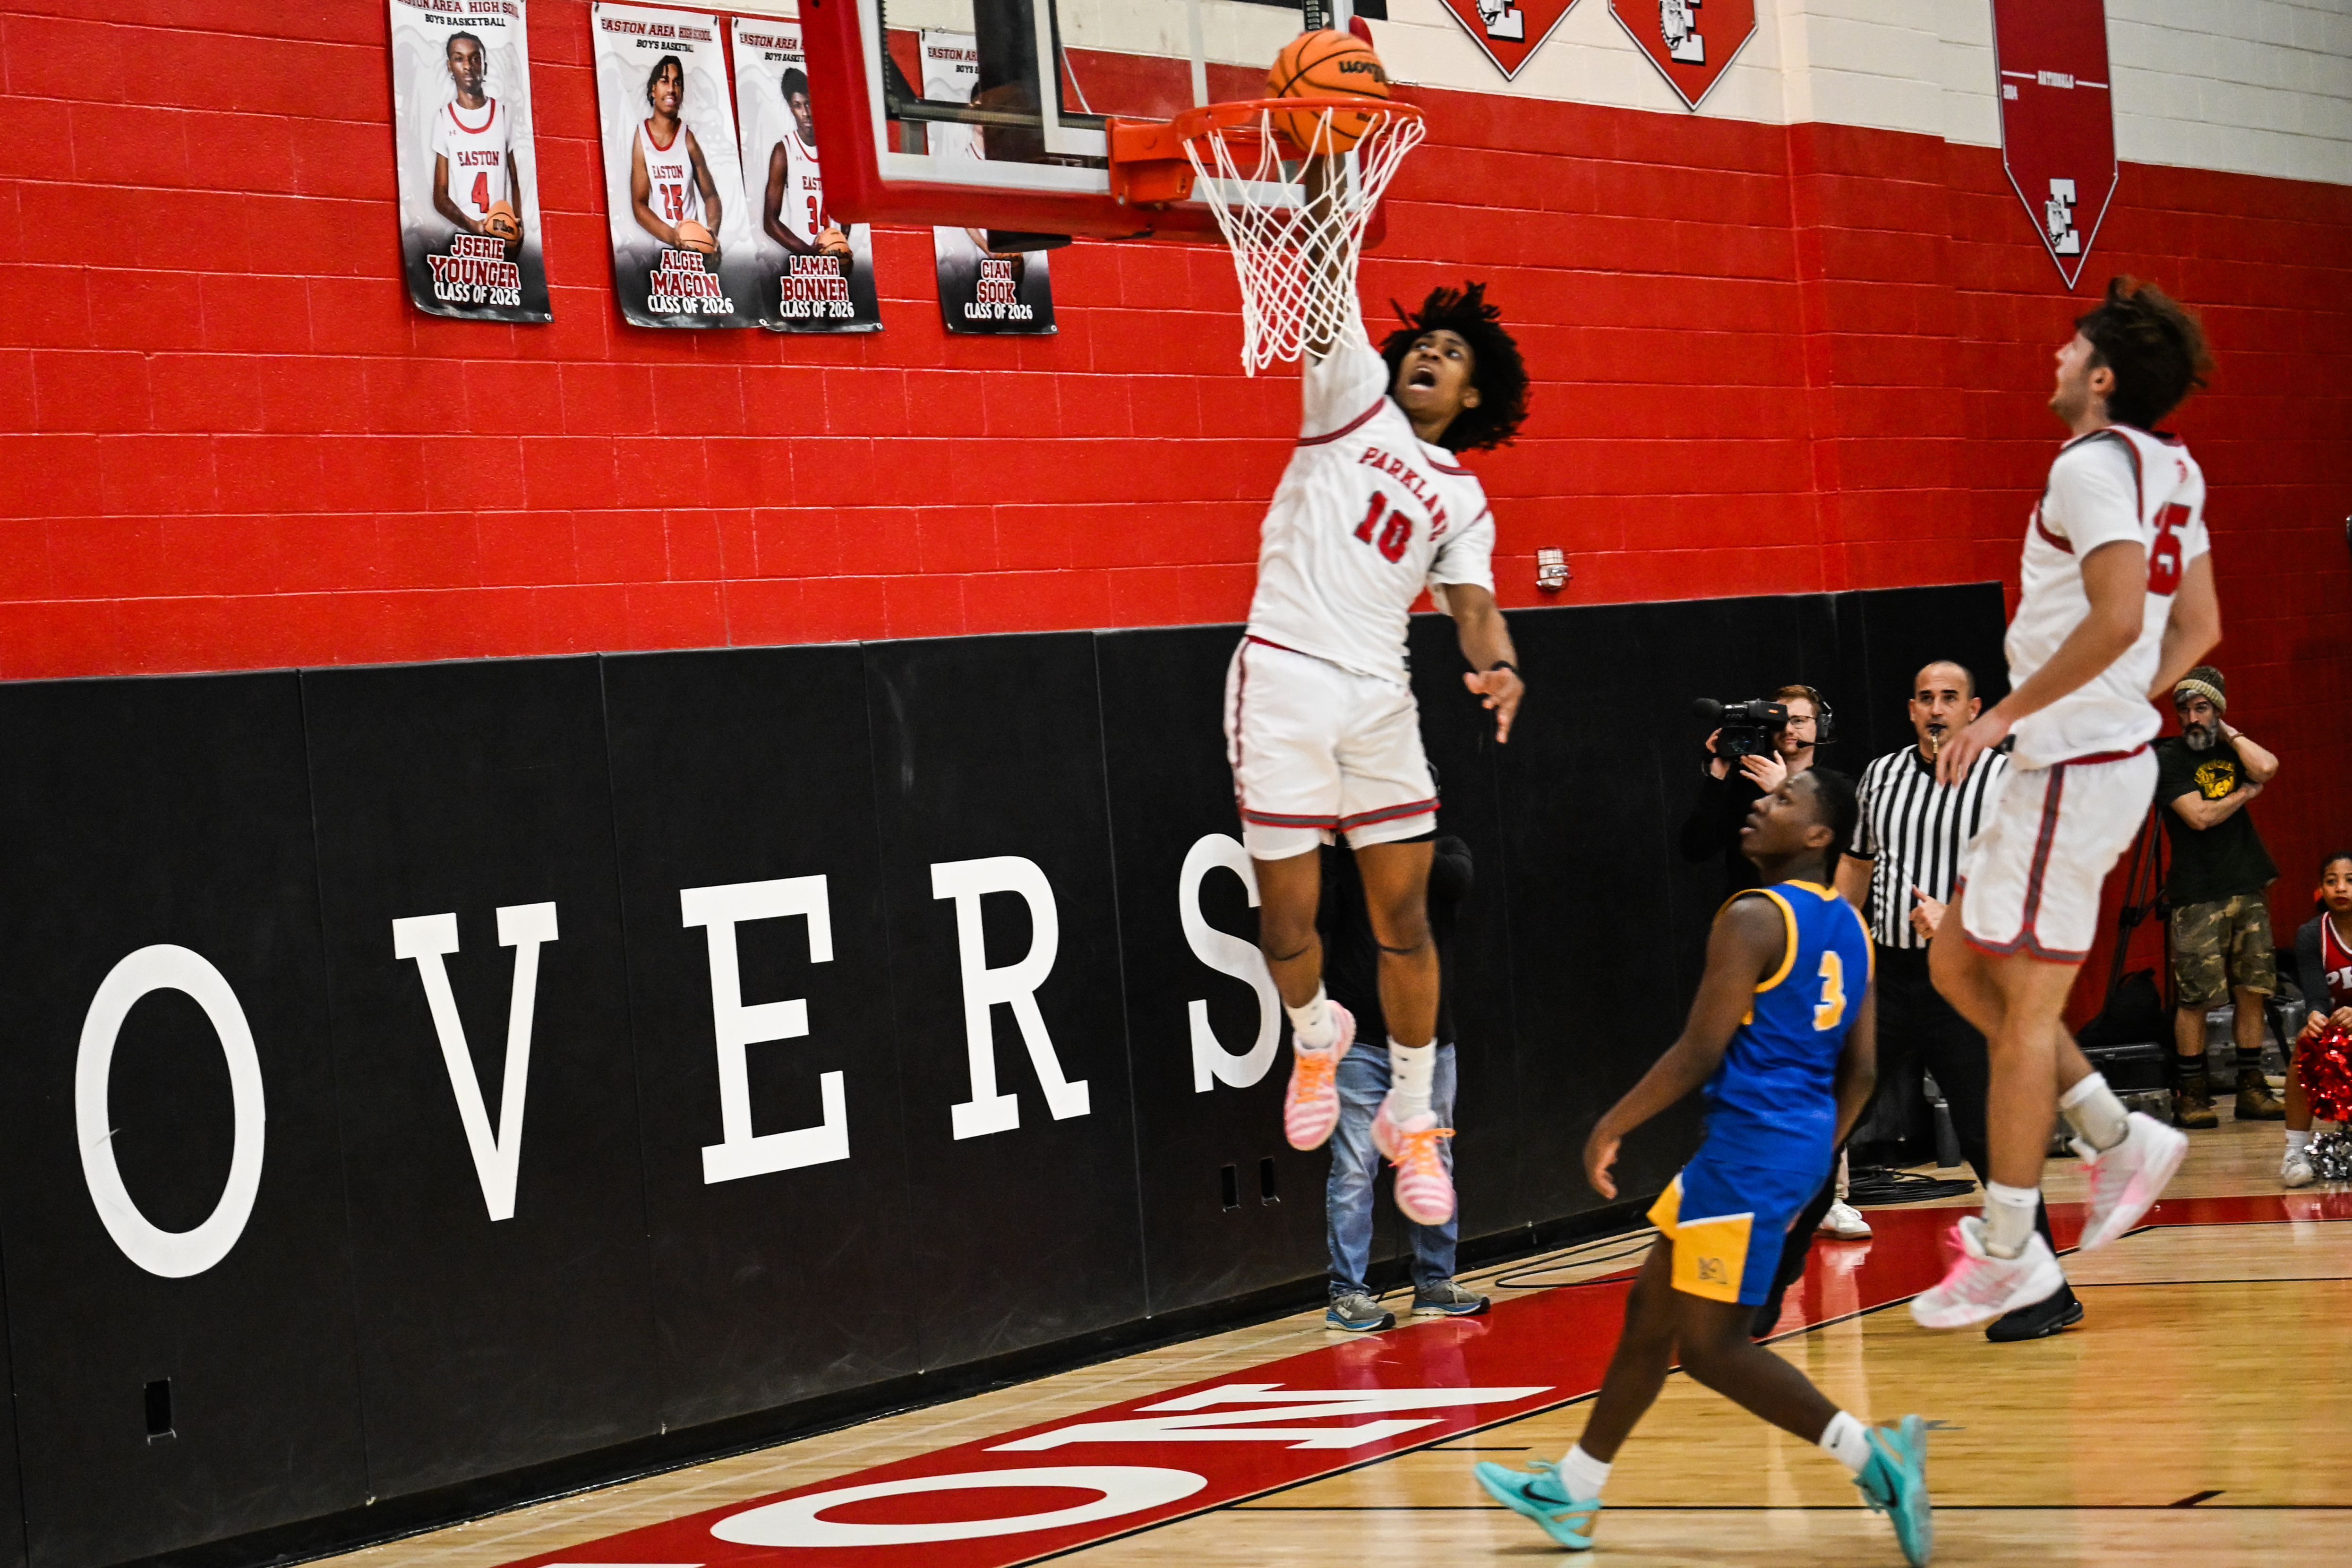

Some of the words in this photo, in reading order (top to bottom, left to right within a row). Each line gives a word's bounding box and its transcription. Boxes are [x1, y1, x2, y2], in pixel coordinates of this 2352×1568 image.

[432, 0, 463, 13] AREA
[470, 1, 500, 13] HIGH
[425, 14, 445, 24] BOYS
[447, 17, 506, 27] BASKETBALL
[601, 18, 647, 34] EASTON
[649, 24, 676, 37] AREA
[636, 39, 659, 50] BOYS
[739, 33, 773, 48] EASTON
[775, 37, 798, 50] AREA
[764, 52, 781, 60] BOYS
[927, 47, 963, 60] EASTON
[956, 64, 973, 73] BOYS
[457, 151, 499, 166] EASTON
[652, 165, 684, 179] EASTON
[471, 171, 489, 214] 4
[450, 234, 505, 261] JSERIE
[660, 249, 706, 274] ALGEE
[789, 255, 840, 277] LAMAR
[981, 259, 1012, 281] CIAN
[427, 254, 522, 290] YOUNGER
[434, 282, 470, 302] CLASS
[473, 284, 488, 303] OF
[489, 287, 521, 306] 2026
[650, 270, 723, 299] MACON
[780, 276, 849, 302] BONNER
[976, 279, 1017, 305] SOOK
[648, 295, 681, 313] CLASS
[682, 296, 699, 314] OF
[701, 297, 735, 314] 2026
[779, 300, 811, 318] CLASS
[813, 300, 826, 318] OF
[829, 301, 855, 318] 2026
[964, 302, 992, 319] CLASS
[994, 302, 1006, 319] OF
[1008, 304, 1033, 320] 2026
[1353, 490, 1413, 564] 10
[1812, 950, 1847, 1032] 3
[75, 833, 1282, 1279] OVERS
